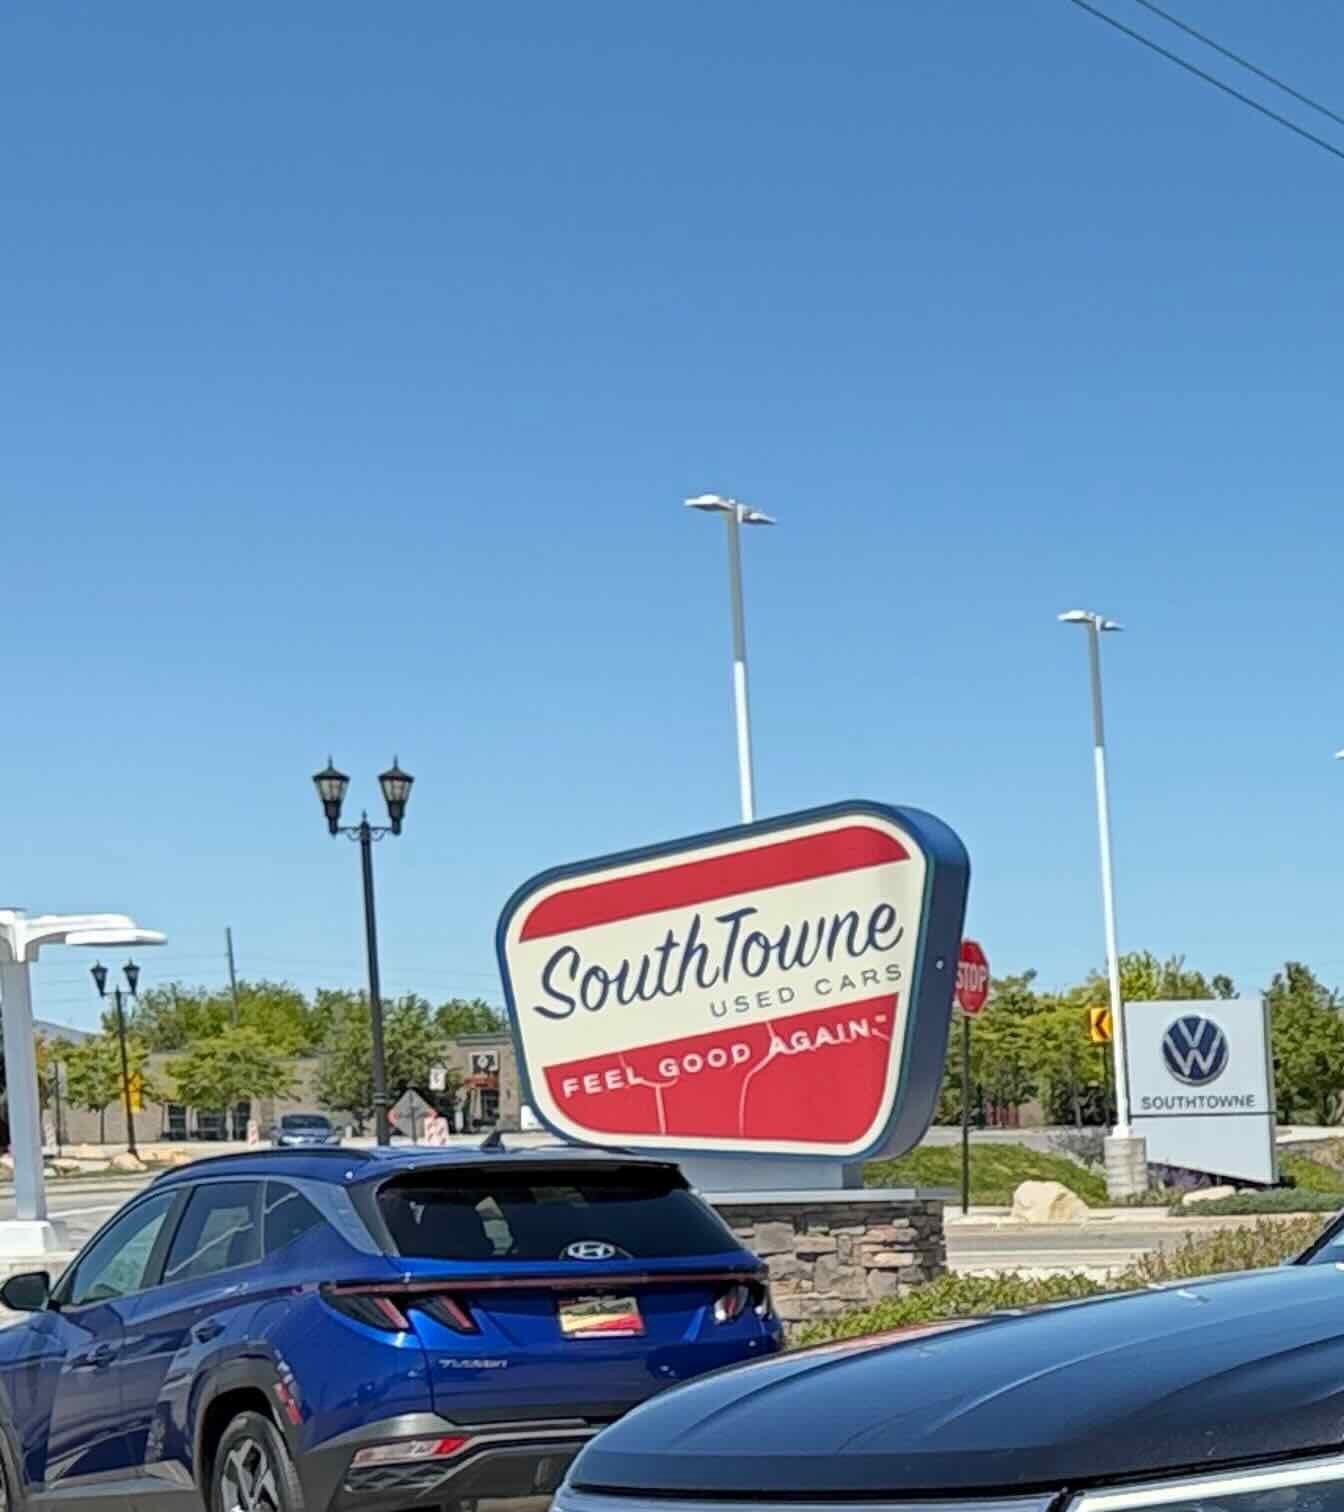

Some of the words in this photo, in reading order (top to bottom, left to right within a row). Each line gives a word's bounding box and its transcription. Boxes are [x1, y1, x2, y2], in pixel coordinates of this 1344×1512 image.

[532, 902, 904, 1020] SouthTowne
[955, 961, 987, 992] STOP
[710, 986, 795, 1018] USED
[815, 963, 902, 996] CARS
[562, 1065, 644, 1099] FEEL
[658, 1043, 751, 1078] GOOD
[1140, 1094, 1256, 1111] SOUTHTOWNE
